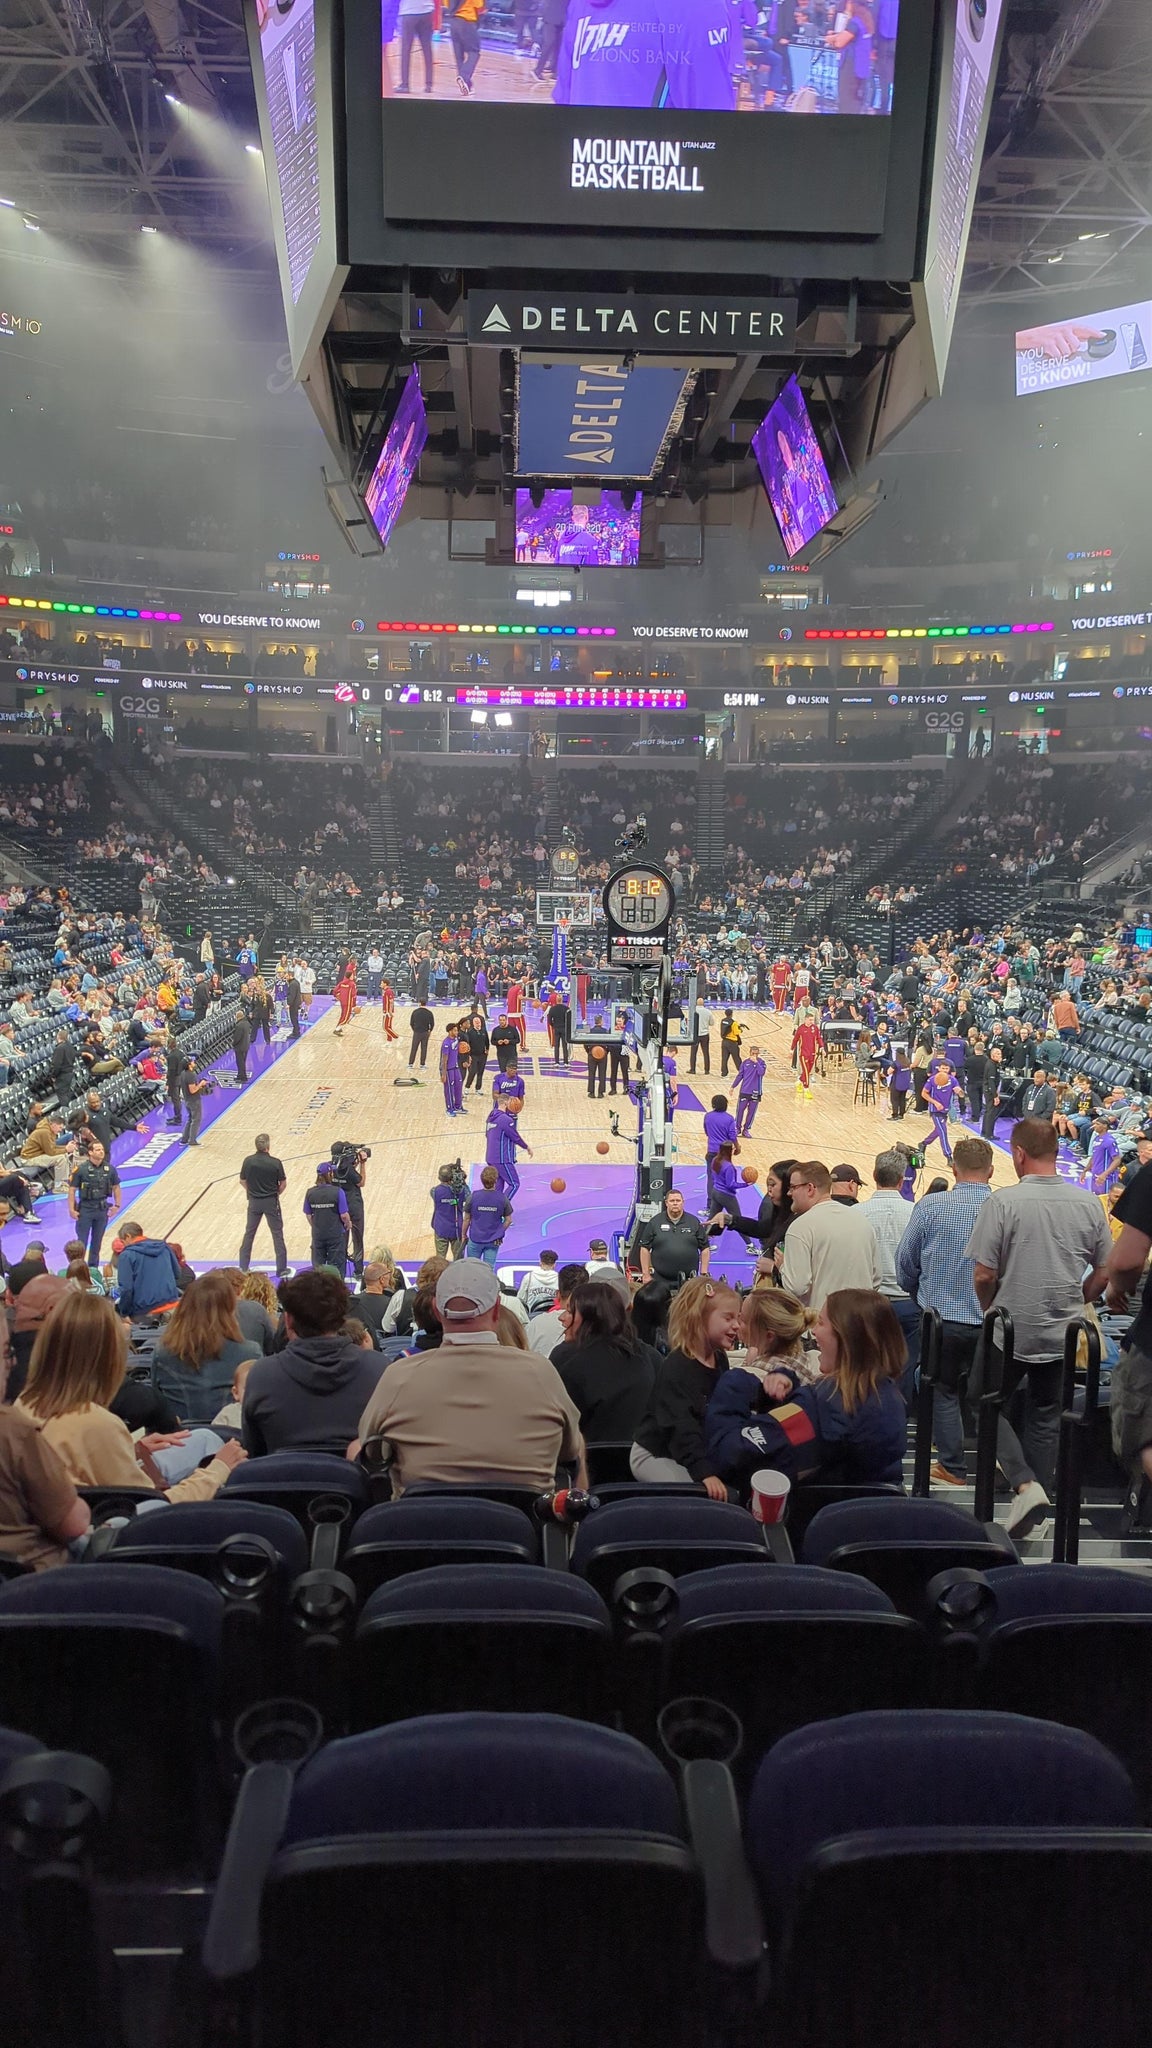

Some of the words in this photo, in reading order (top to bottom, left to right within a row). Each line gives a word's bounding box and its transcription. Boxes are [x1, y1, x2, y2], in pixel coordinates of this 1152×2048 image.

[669, 23, 683, 33] BY
[572, 16, 630, 70] UTAH
[589, 48, 640, 64] ZIONS
[646, 49, 692, 65] BANK
[573, 138, 681, 166] MOUNTAIN
[682, 141, 699, 149] UTAH
[571, 163, 704, 191] BASKETBALL
[522, 306, 638, 333] DELTA
[654, 309, 784, 336] CENTER
[1020, 346, 1044, 361] YOU
[1021, 354, 1069, 375] DESERVE
[1021, 376, 1037, 389] TO
[1040, 362, 1091, 386] KNOW!
[569, 364, 628, 443] DELTA
[199, 613, 221, 624] YOU
[223, 614, 268, 627] DESERVE
[270, 617, 284, 628] TO
[286, 618, 320, 629] KNOW!
[1072, 618, 1095, 630] YOU
[1097, 613, 1145, 628] DESERVE
[632, 626, 652, 637] YOU
[655, 627, 698, 638] DESERVE
[700, 627, 713, 638] TO
[715, 628, 749, 639] KNOW!
[30, 670, 65, 682] PRYSM
[154, 680, 167, 688] NU
[168, 681, 187, 689] SKIN
[257, 685, 290, 693] PRYSM
[362, 688, 370, 700] 0
[385, 688, 392, 700] 0
[423, 690, 442, 702] 8:12
[724, 693, 743, 706] 6:54
[744, 694, 759, 706] PM
[798, 696, 810, 704] NU
[811, 696, 828, 704] SKIN
[901, 695, 934, 703] PRYSM
[1020, 692, 1033, 700] NU
[1035, 691, 1053, 699] SKIN
[120, 696, 160, 713] G2G
[925, 711, 964, 728] G2G
[628, 880, 660, 895] 8:12
[627, 937, 665, 945] TISSOT
[304, 1091, 332, 1109] DELTA
[749, 1426, 768, 1445] NIKE
